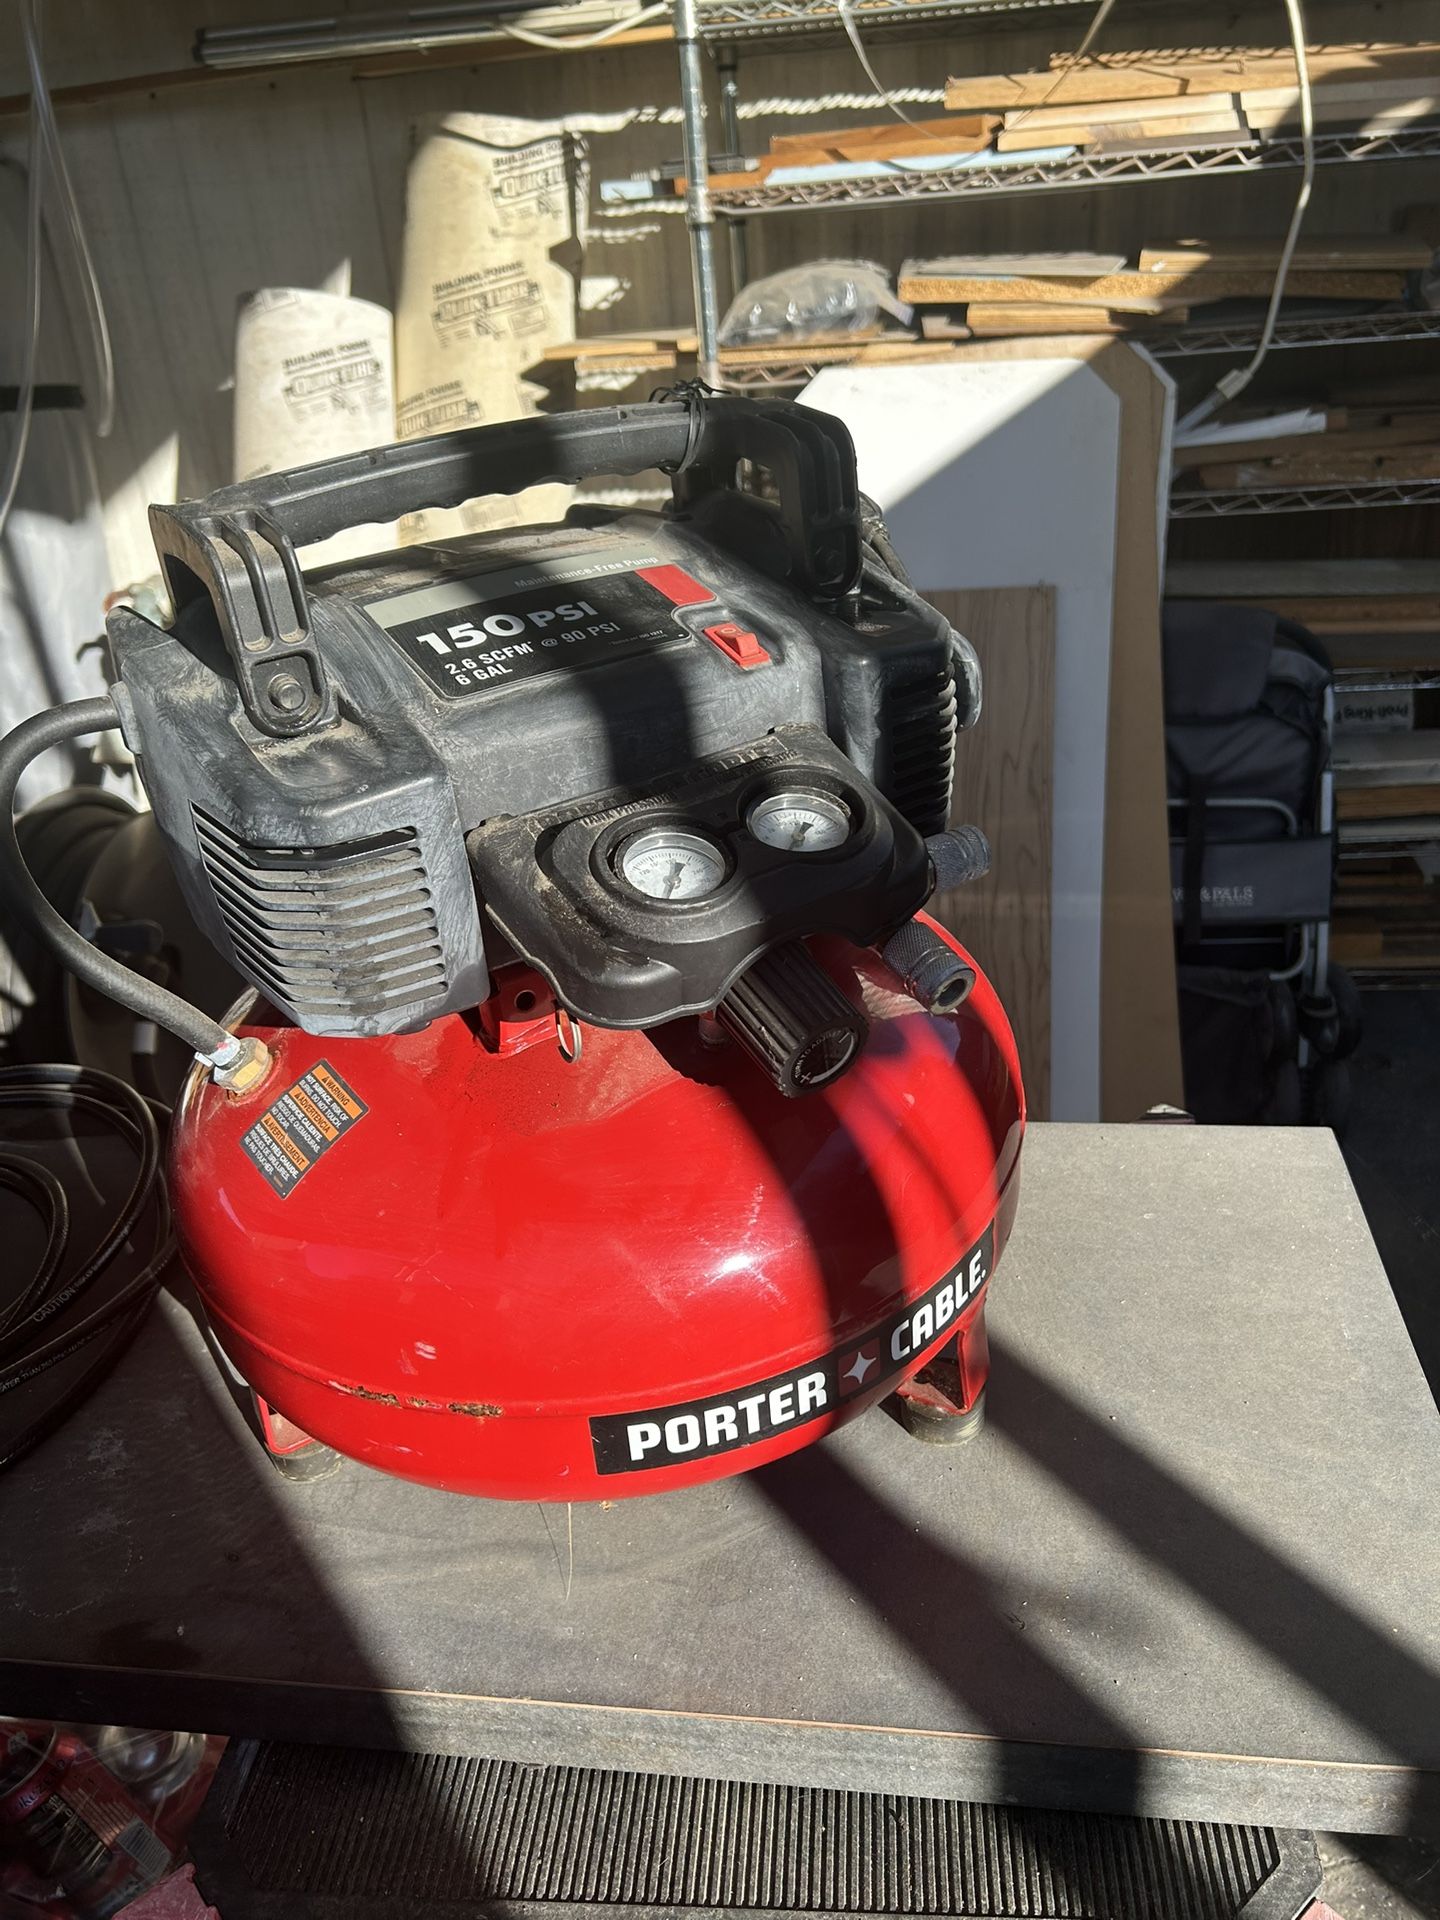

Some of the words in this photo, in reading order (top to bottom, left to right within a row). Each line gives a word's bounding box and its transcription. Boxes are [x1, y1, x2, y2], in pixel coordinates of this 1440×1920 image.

[623, 555, 659, 568] Pump
[416, 614, 525, 654] 150
[526, 601, 598, 628] PSI
[445, 657, 476, 675] 2.6
[541, 636, 559, 648] @
[561, 629, 586, 644] 90
[587, 621, 621, 638] PSI
[455, 673, 471, 686] 6
[473, 664, 513, 681] GAL
[311, 1093, 321, 1103] DO
[325, 1078, 350, 1106] WARNING
[287, 1114, 296, 1123] DE
[297, 1095, 331, 1134] ADVERTENCIA
[339, 1112, 349, 1122] OF
[262, 1147, 271, 1156] DE
[626, 1372, 828, 1461] PORTER
